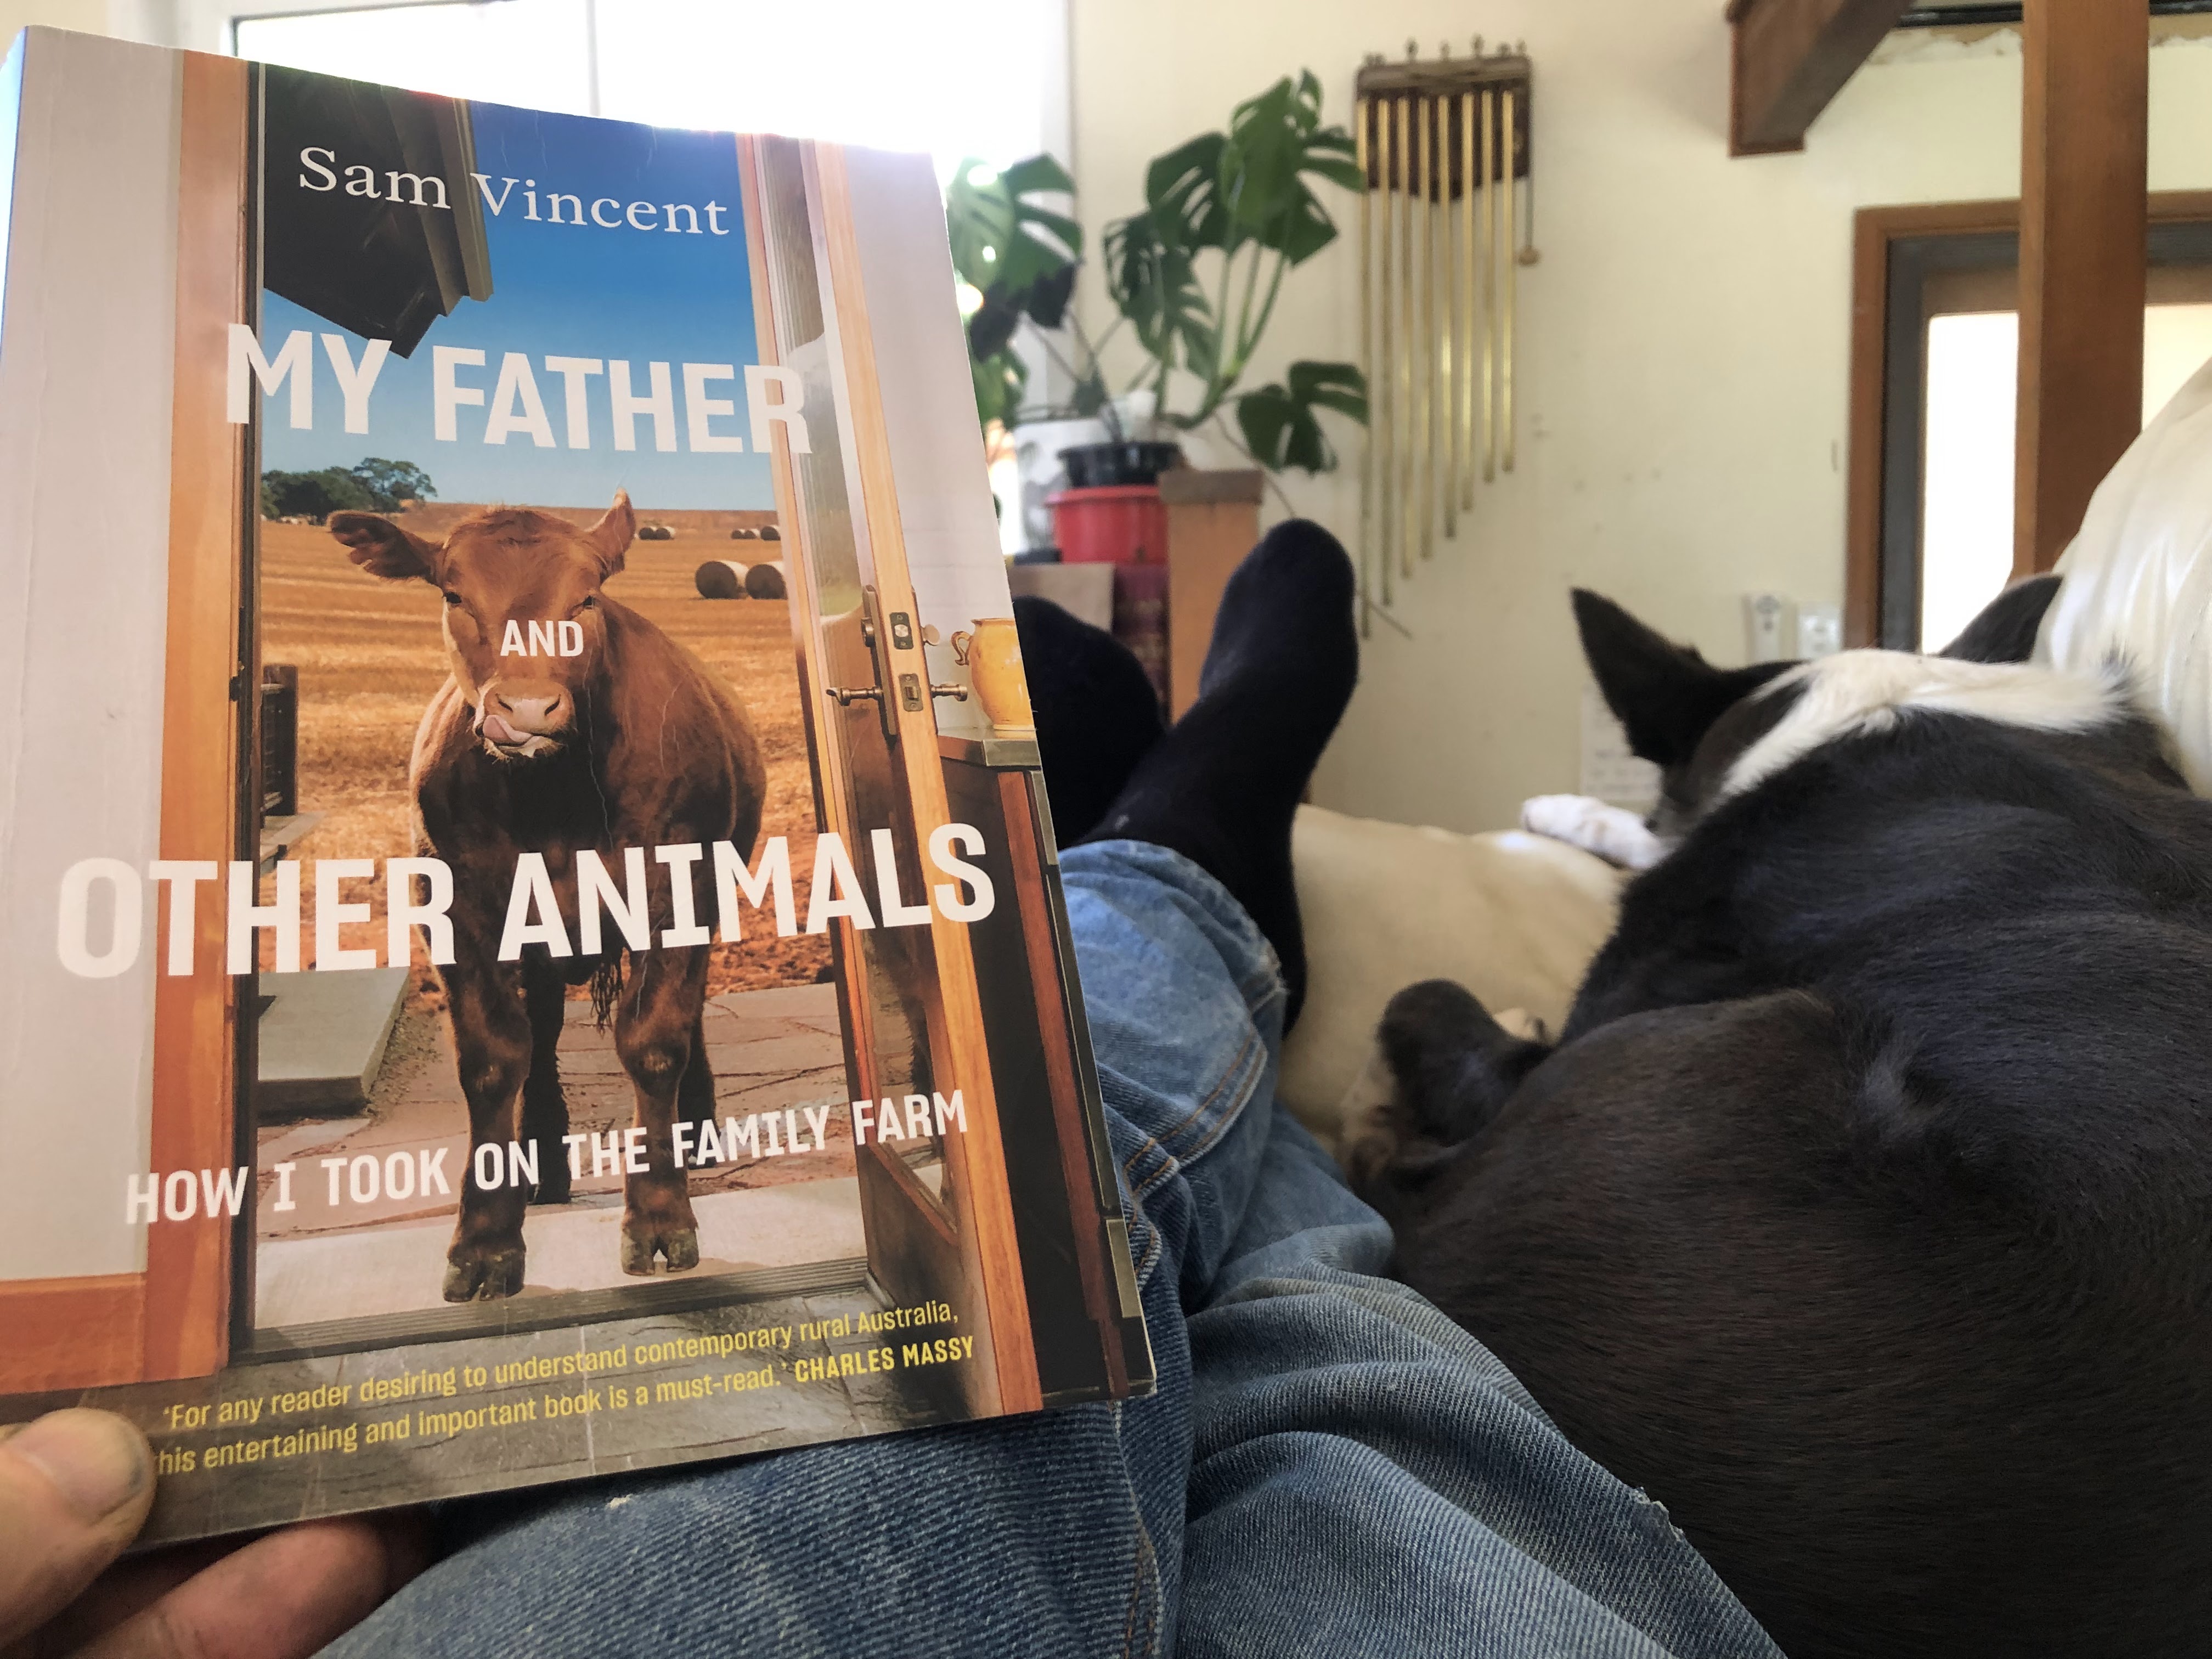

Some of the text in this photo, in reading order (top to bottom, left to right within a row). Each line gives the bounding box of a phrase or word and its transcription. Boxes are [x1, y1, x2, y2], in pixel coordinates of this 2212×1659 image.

[300, 146, 730, 235] Sam Vincent
[227, 323, 812, 454] MY FATHER
[500, 619, 584, 658] AND
[58, 822, 995, 978] OTHER ANIMALS
[126, 1090, 968, 1224] HOW I TOOK ON THE FAMILY FARM
[157, 1447, 196, 1475] his
[204, 1423, 357, 1468] entertaining
[366, 1414, 410, 1444] and
[419, 1394, 536, 1435] important
[545, 1391, 601, 1418] book
[609, 1386, 628, 1409] is
[636, 1384, 649, 1406] a
[795, 1347, 894, 1382] CHARLES
[902, 1335, 974, 1367] MASSY
[219, 1397, 263, 1424] any
[271, 1383, 352, 1414] reader
[359, 1367, 455, 1403] desiring
[463, 1364, 485, 1389] to
[495, 1343, 627, 1383] understand
[634, 1324, 792, 1364] contemporary
[799, 1314, 850, 1346] rural
[858, 1299, 959, 1334] Australia,
